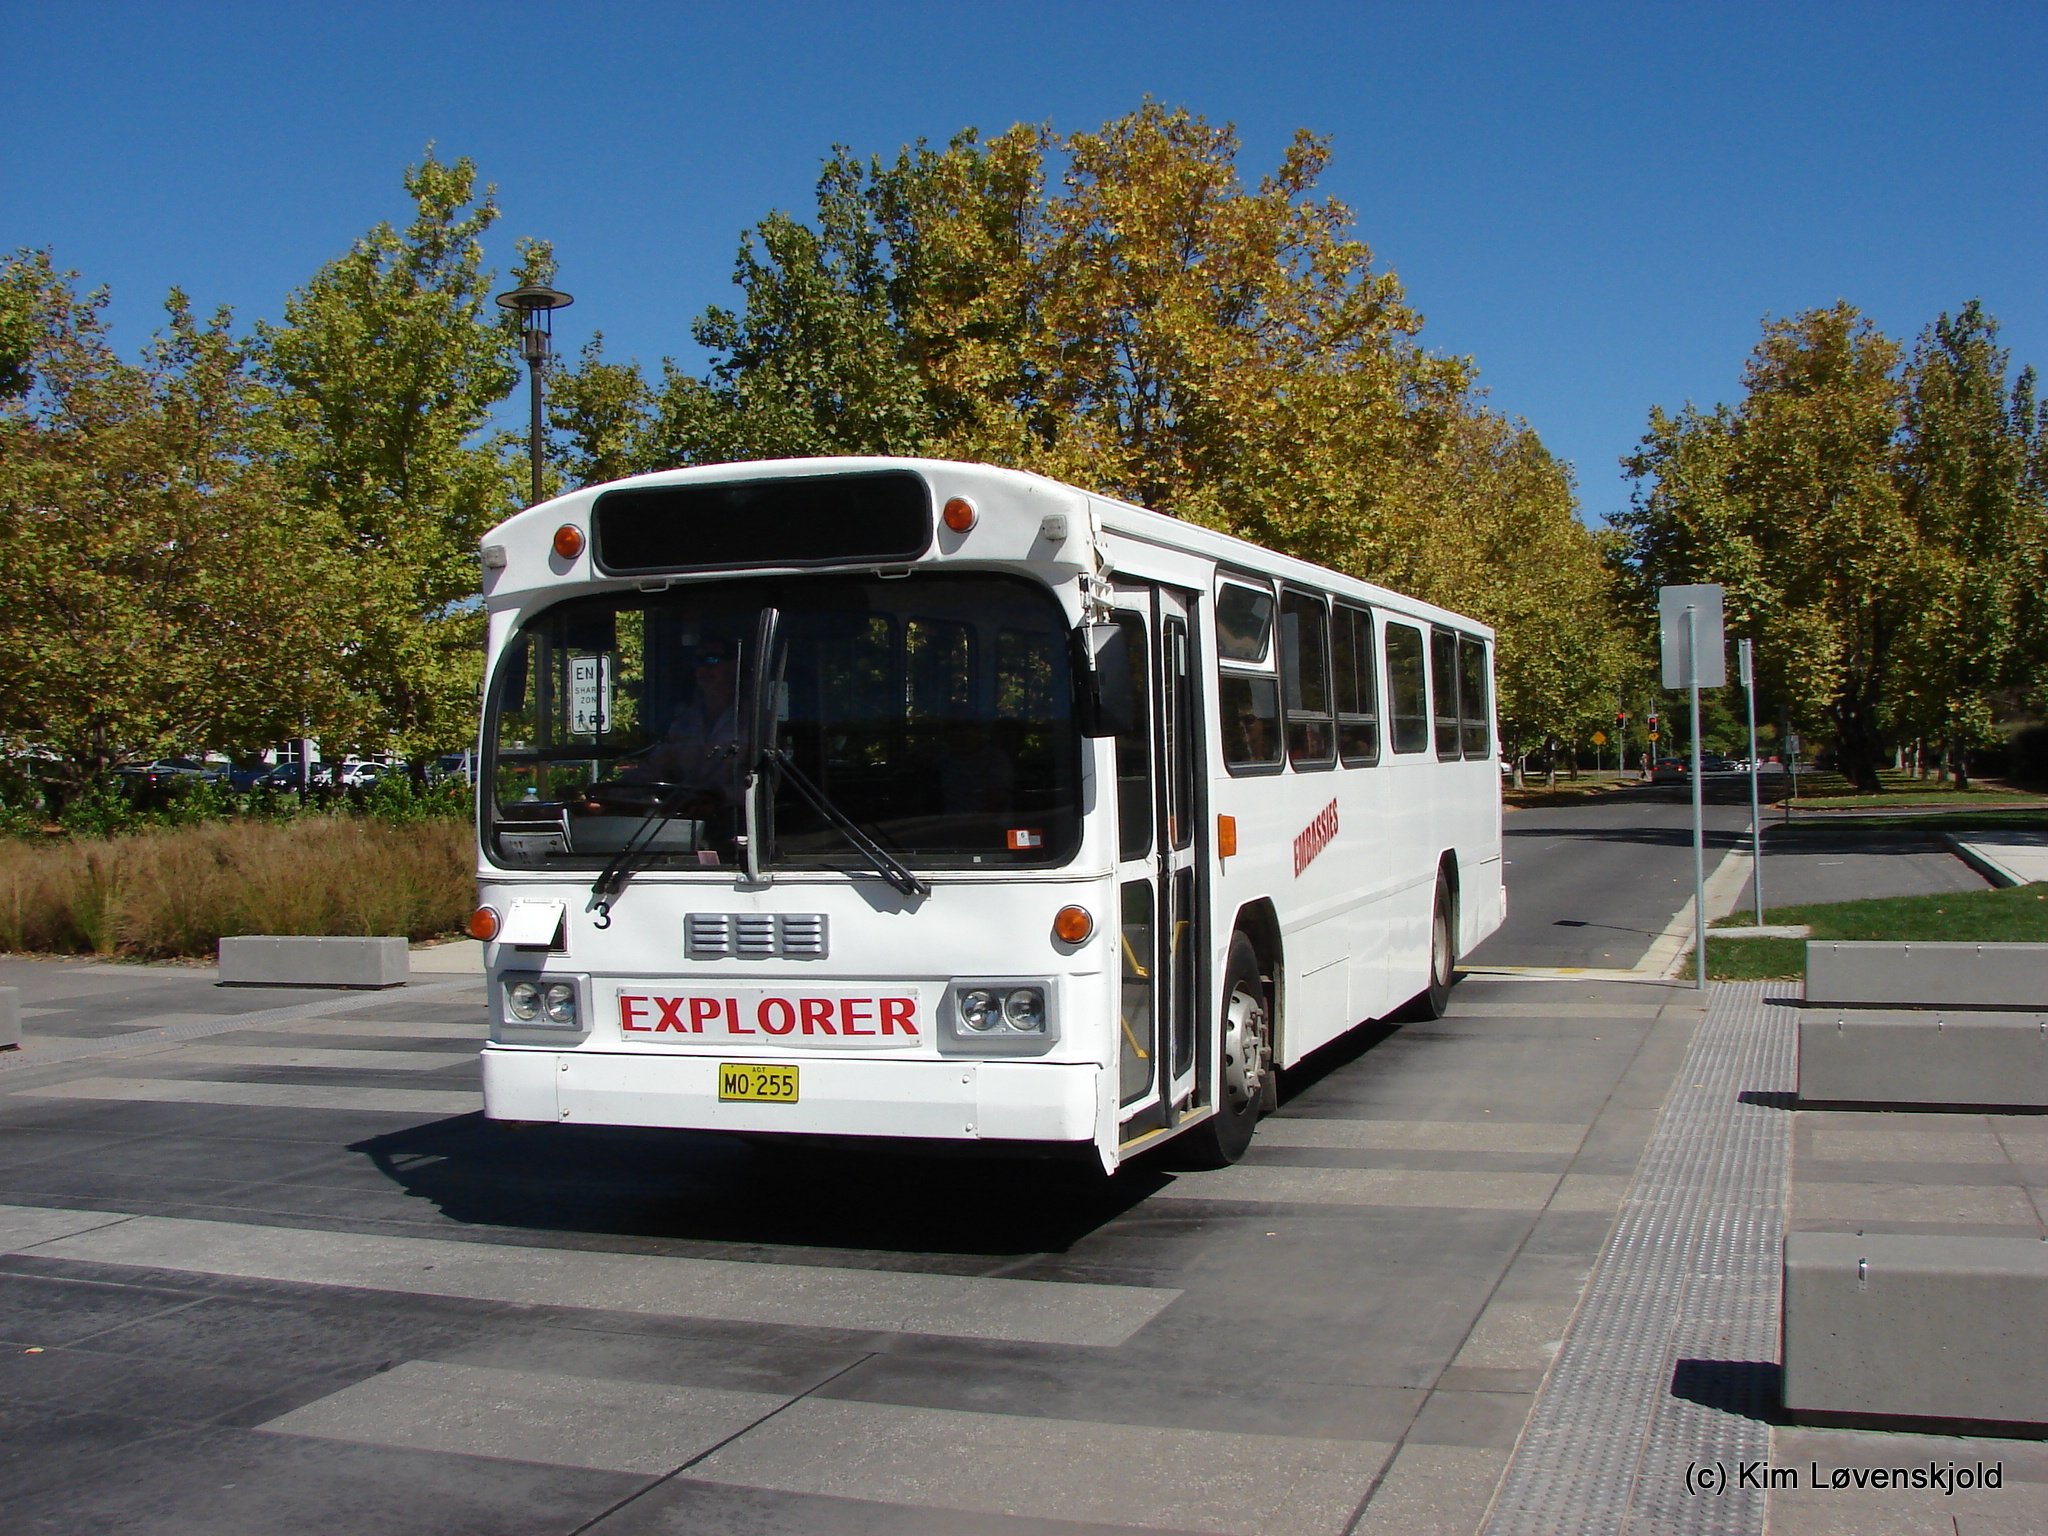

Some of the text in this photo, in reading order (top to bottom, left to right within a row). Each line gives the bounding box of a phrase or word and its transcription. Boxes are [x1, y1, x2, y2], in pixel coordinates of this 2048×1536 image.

[575, 686, 607, 694] SHARD
[1293, 797, 1339, 879] EMBASSIES
[593, 901, 612, 930] 3
[620, 995, 919, 1036] EXPLORER
